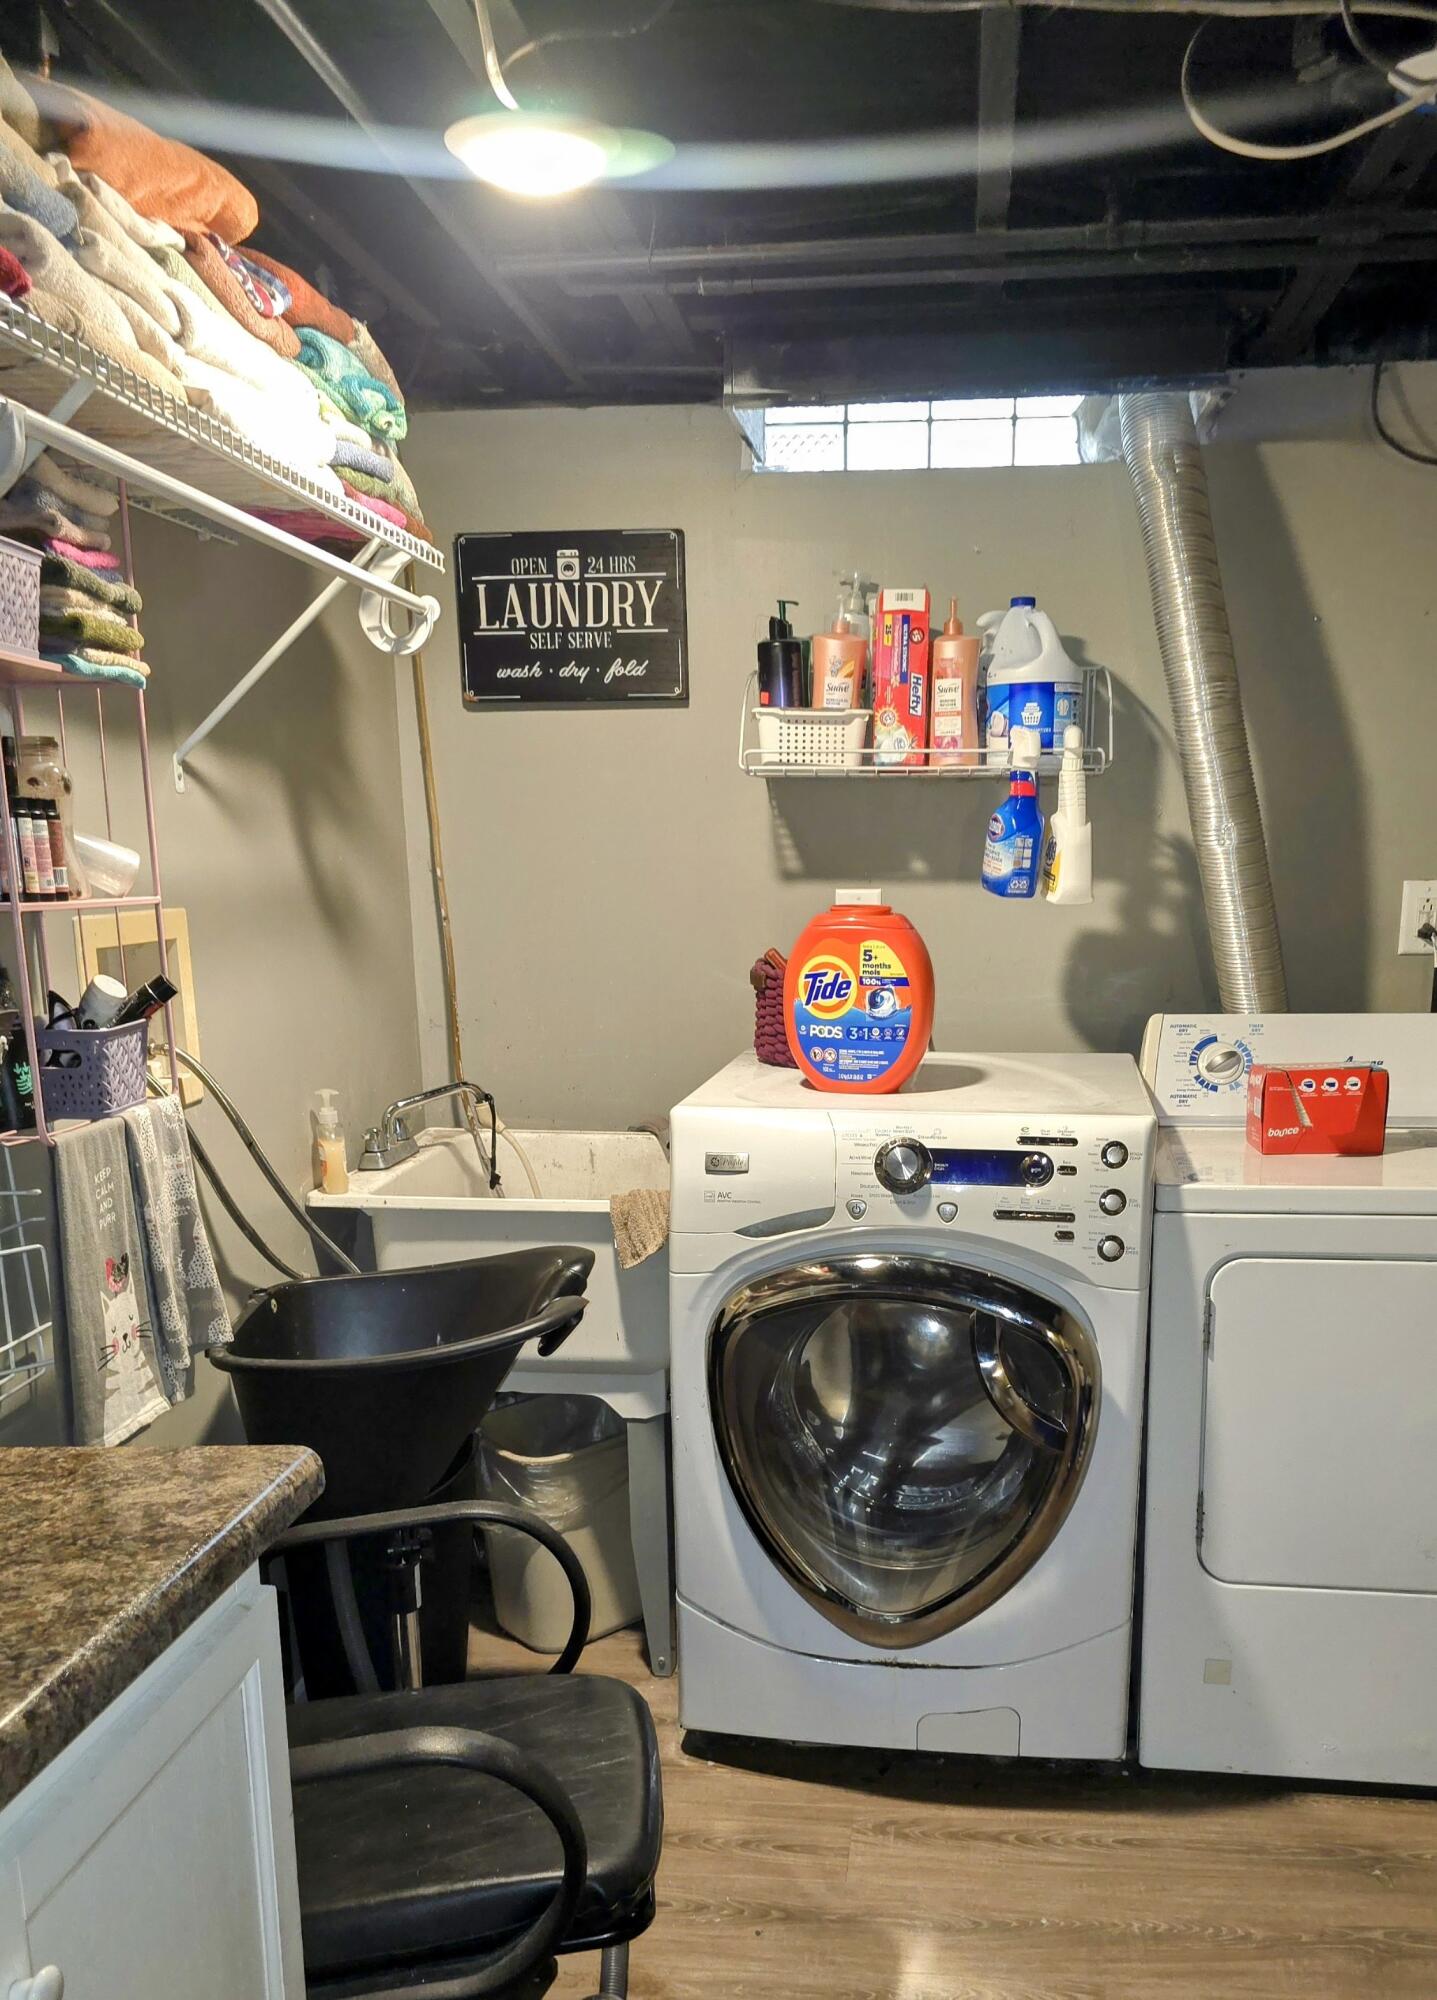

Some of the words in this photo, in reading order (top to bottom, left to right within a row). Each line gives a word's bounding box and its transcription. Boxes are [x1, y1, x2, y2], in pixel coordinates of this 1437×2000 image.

[511, 557, 547, 575] OPEN
[587, 556, 604, 574] 24
[609, 555, 636, 573] HRS
[476, 579, 664, 629] LAUNDRY
[885, 624, 892, 635] 25
[529, 632, 563, 650] SELF
[568, 631, 612, 649] SERVE
[496, 661, 543, 679] wash
[559, 660, 590, 684] dry
[604, 657, 649, 684] fold
[826, 682, 850, 693] Suave
[911, 675, 922, 714] Hefty
[937, 684, 960, 694] Suave
[804, 971, 852, 1006] Tide
[809, 1024, 843, 1039] PODS
[1267, 1127, 1300, 1138] bounce
[94, 1167, 111, 1184] KEEP
[95, 1182, 114, 1199] CALM
[100, 1197, 113, 1213] AND
[99, 1212, 116, 1230] PURR
